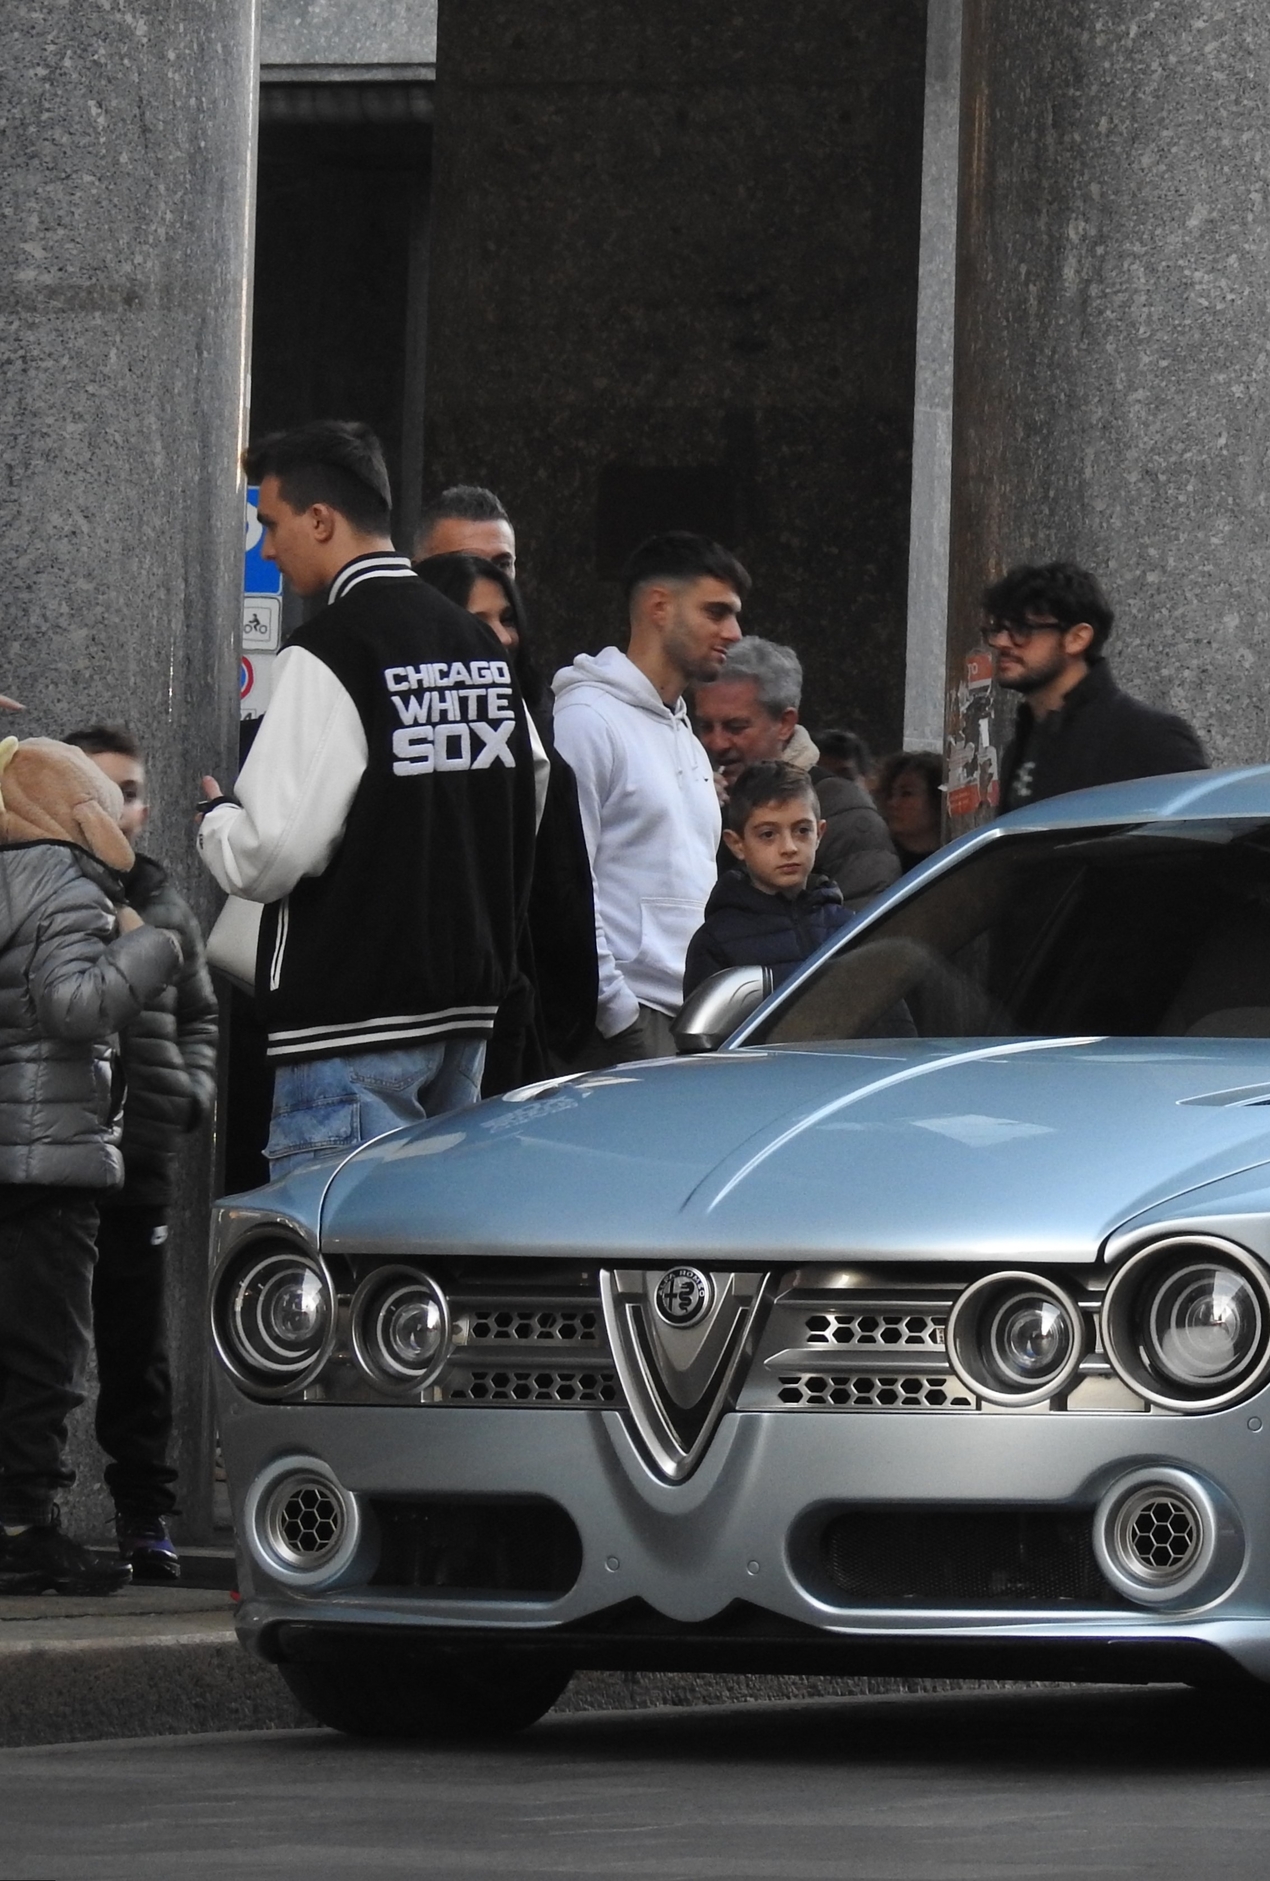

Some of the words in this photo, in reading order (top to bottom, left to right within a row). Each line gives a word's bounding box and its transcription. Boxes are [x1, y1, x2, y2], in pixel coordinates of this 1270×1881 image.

[384, 660, 511, 691] CHICAGO
[391, 689, 515, 724] WHITE
[392, 720, 516, 776] SOX
[658, 1273, 676, 1296] ALFA
[679, 1269, 705, 1297] ROMEO
